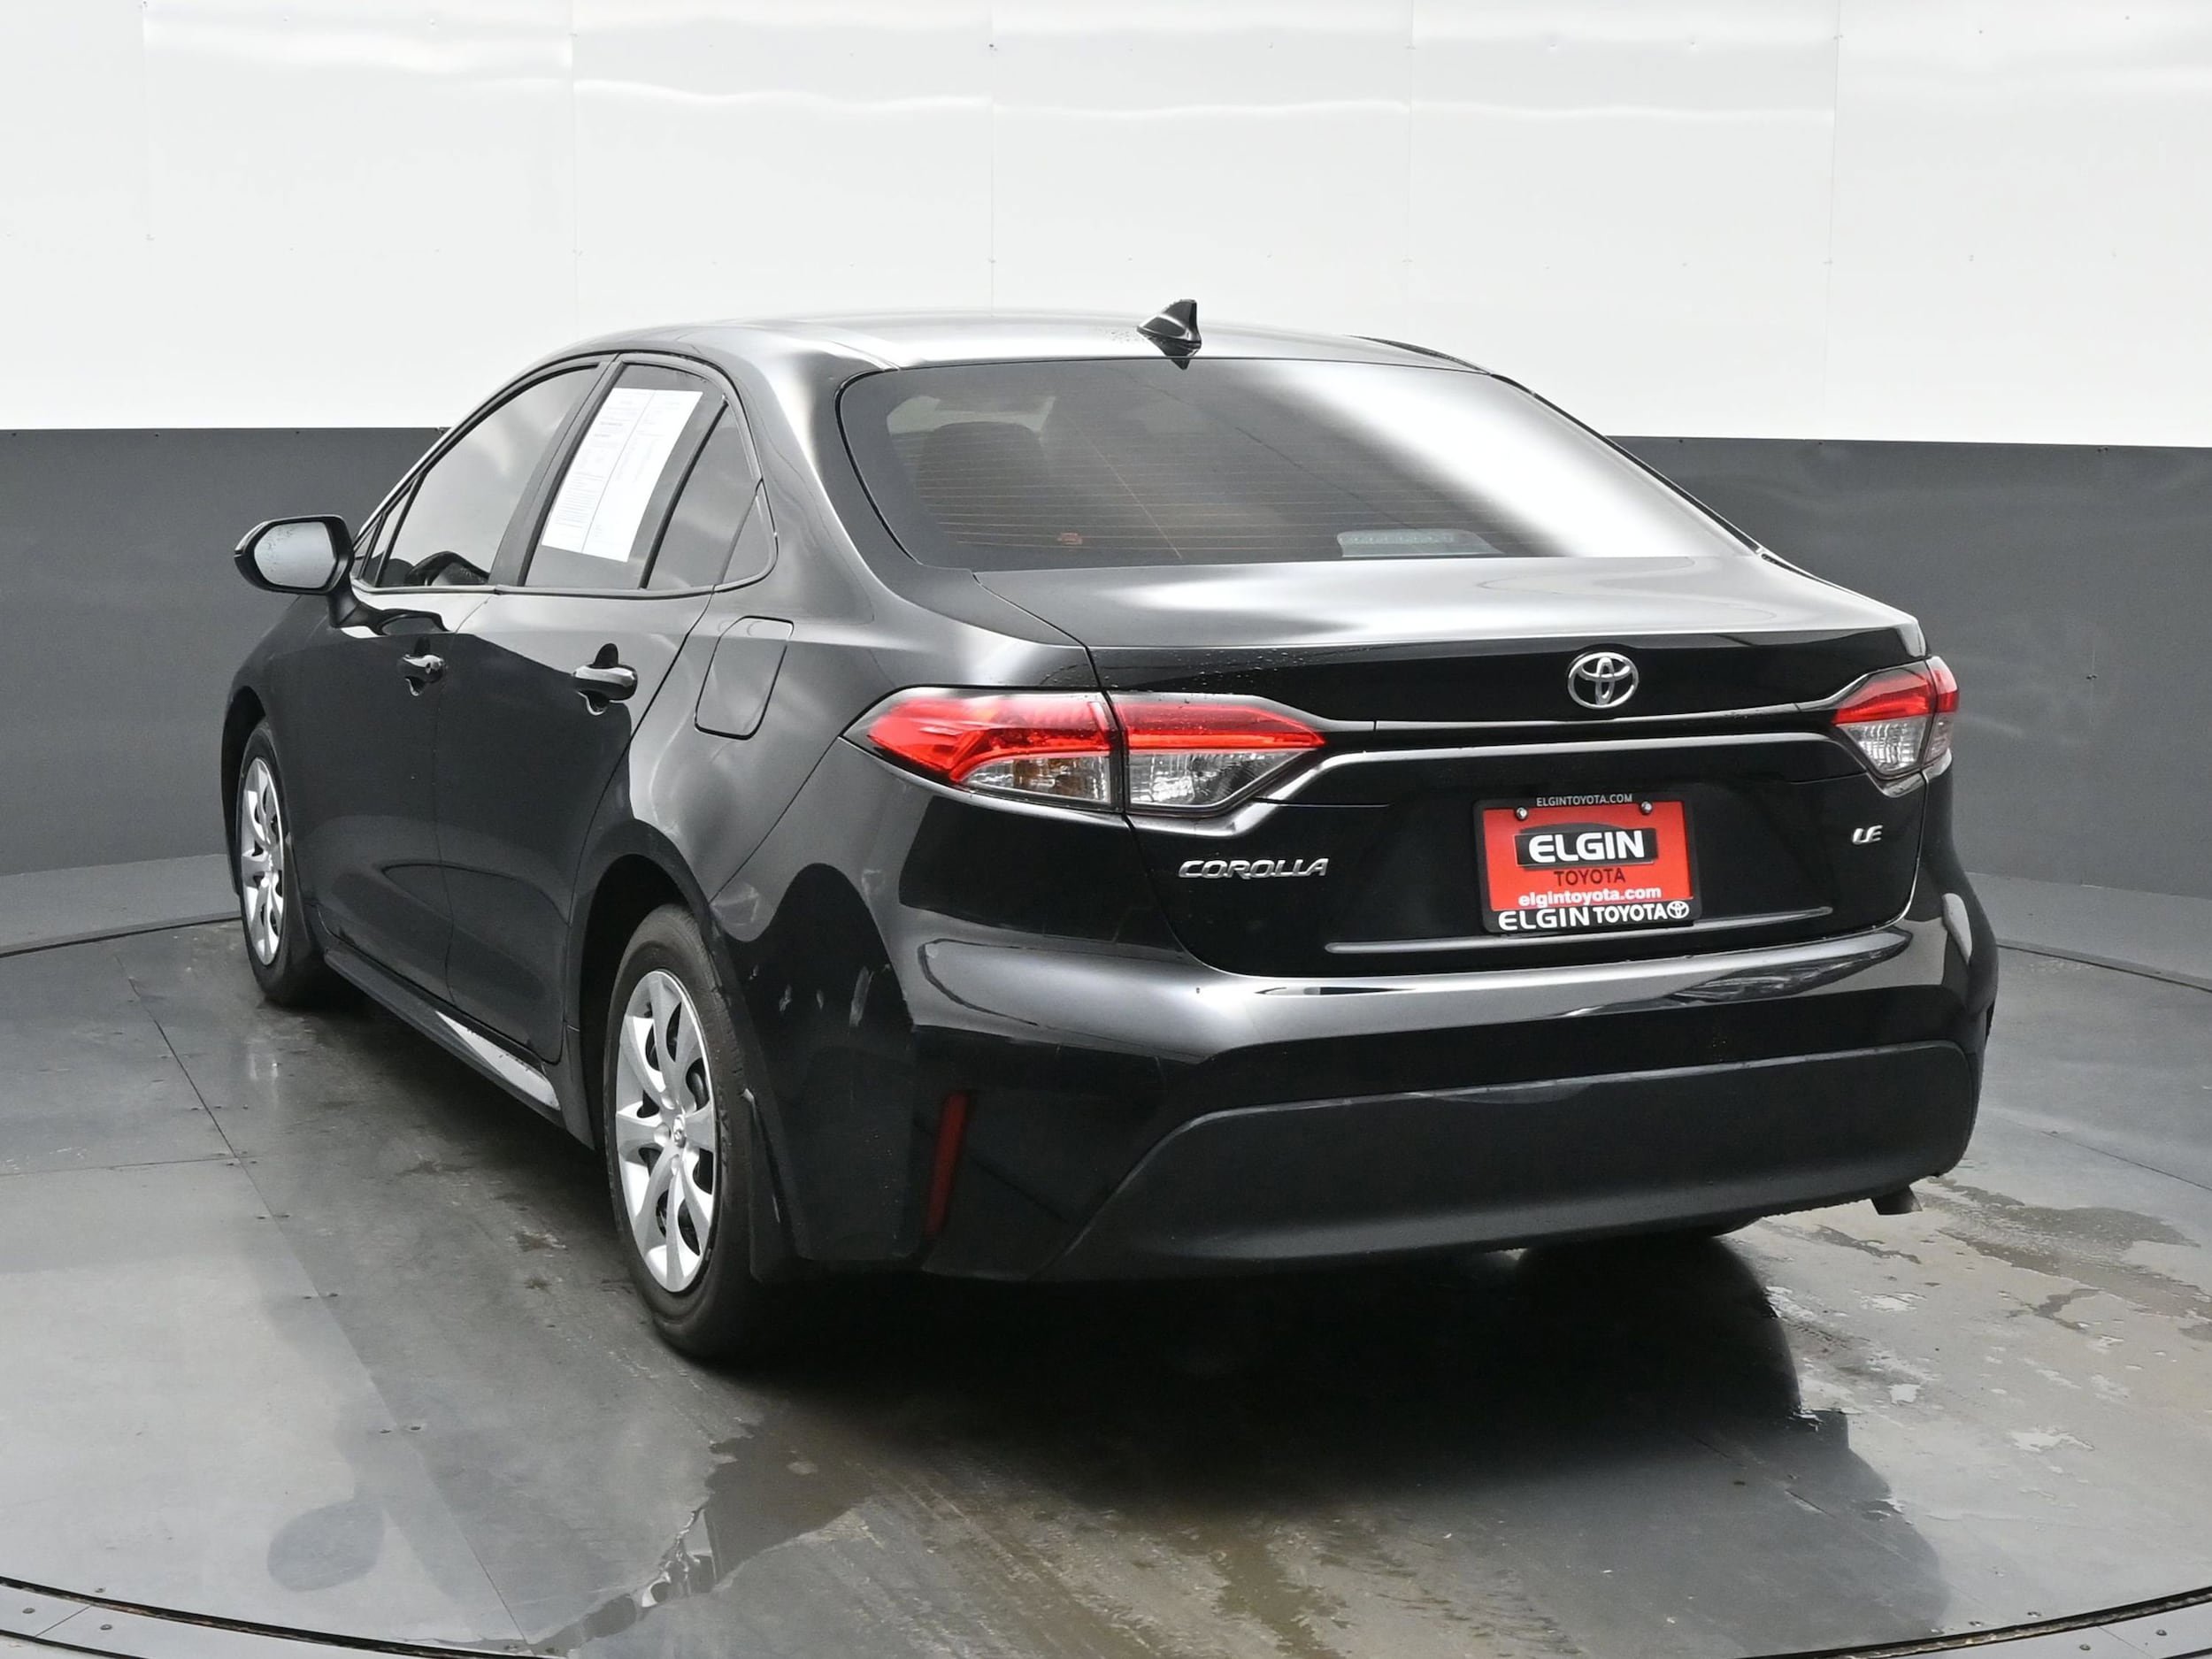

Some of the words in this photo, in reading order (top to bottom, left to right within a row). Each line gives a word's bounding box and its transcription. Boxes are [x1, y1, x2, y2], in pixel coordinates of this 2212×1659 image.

[1536, 794, 1632, 807] ELGINTOYOTA.COM
[1852, 825, 1883, 845] LE
[1528, 829, 1645, 863] ELGIN
[1179, 858, 1329, 879] COROLLA
[1554, 868, 1625, 887] TOYOTA
[1518, 887, 1662, 909] elgintoyota.com
[1498, 906, 1590, 931] ELGIN
[1592, 902, 1668, 924] TOYOTA
